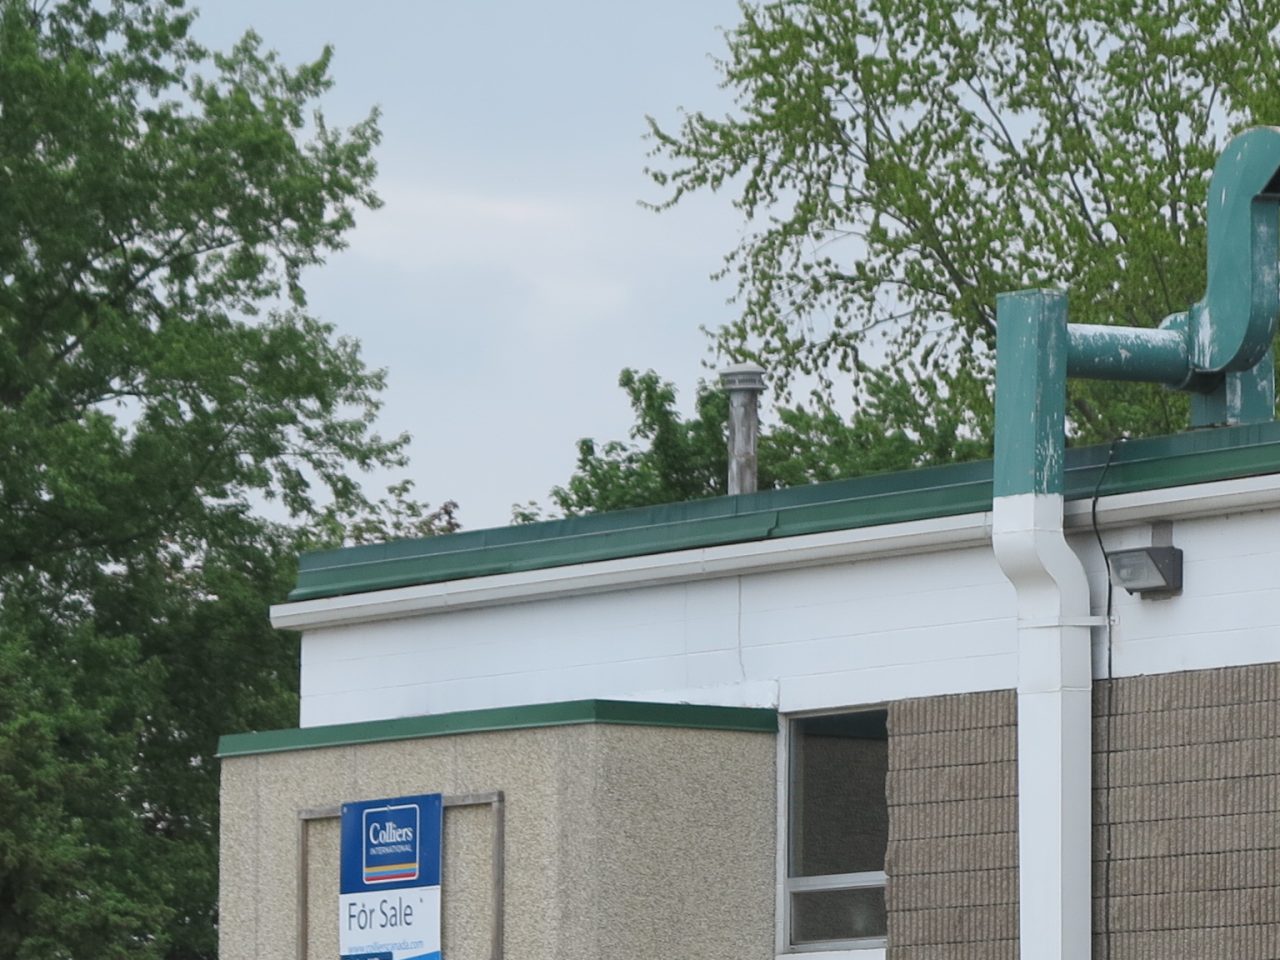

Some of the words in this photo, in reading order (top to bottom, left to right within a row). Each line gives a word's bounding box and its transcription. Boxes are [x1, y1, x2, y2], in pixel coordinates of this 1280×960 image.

[369, 822, 414, 845] Colliers
[369, 844, 413, 855] INTERNATIONAL
[348, 902, 375, 931] For
[380, 896, 413, 928] Sale
